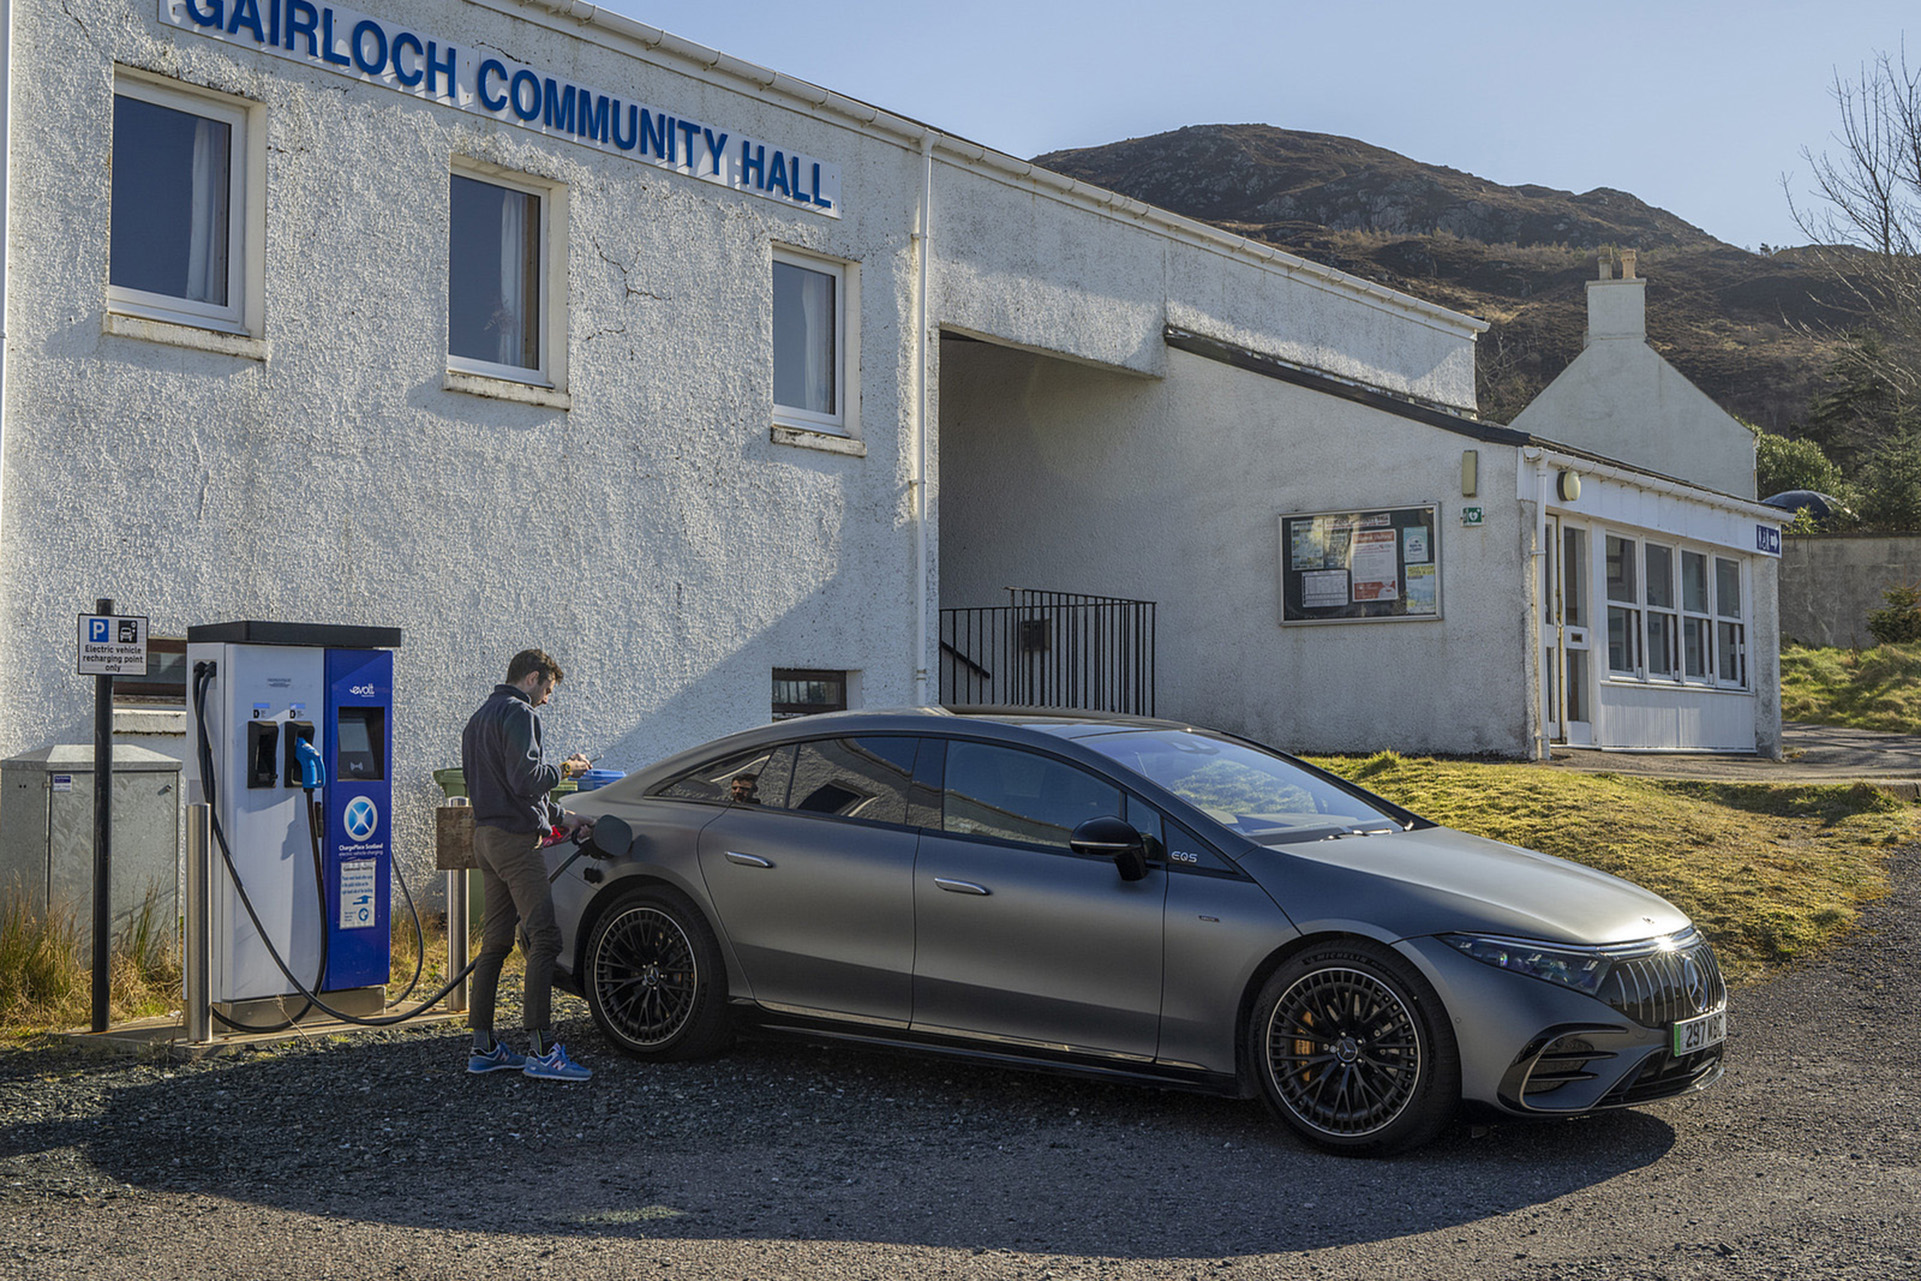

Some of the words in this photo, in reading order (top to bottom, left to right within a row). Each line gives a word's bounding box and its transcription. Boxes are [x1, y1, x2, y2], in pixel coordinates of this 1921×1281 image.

[186, 0, 456, 98] GAIRLOCH
[477, 58, 729, 176] COMMUNITY
[742, 140, 832, 209] HALL
[93, 621, 105, 640] P
[84, 645, 114, 654] Electric
[115, 646, 142, 654] vehicle
[83, 654, 122, 664] recharging
[124, 655, 143, 664] point
[105, 664, 121, 672] only
[1171, 850, 1198, 863] EQS
[1317, 952, 1368, 964] MICHELIN
[1686, 1021, 1706, 1048] 297
[551, 1060, 566, 1071] N
